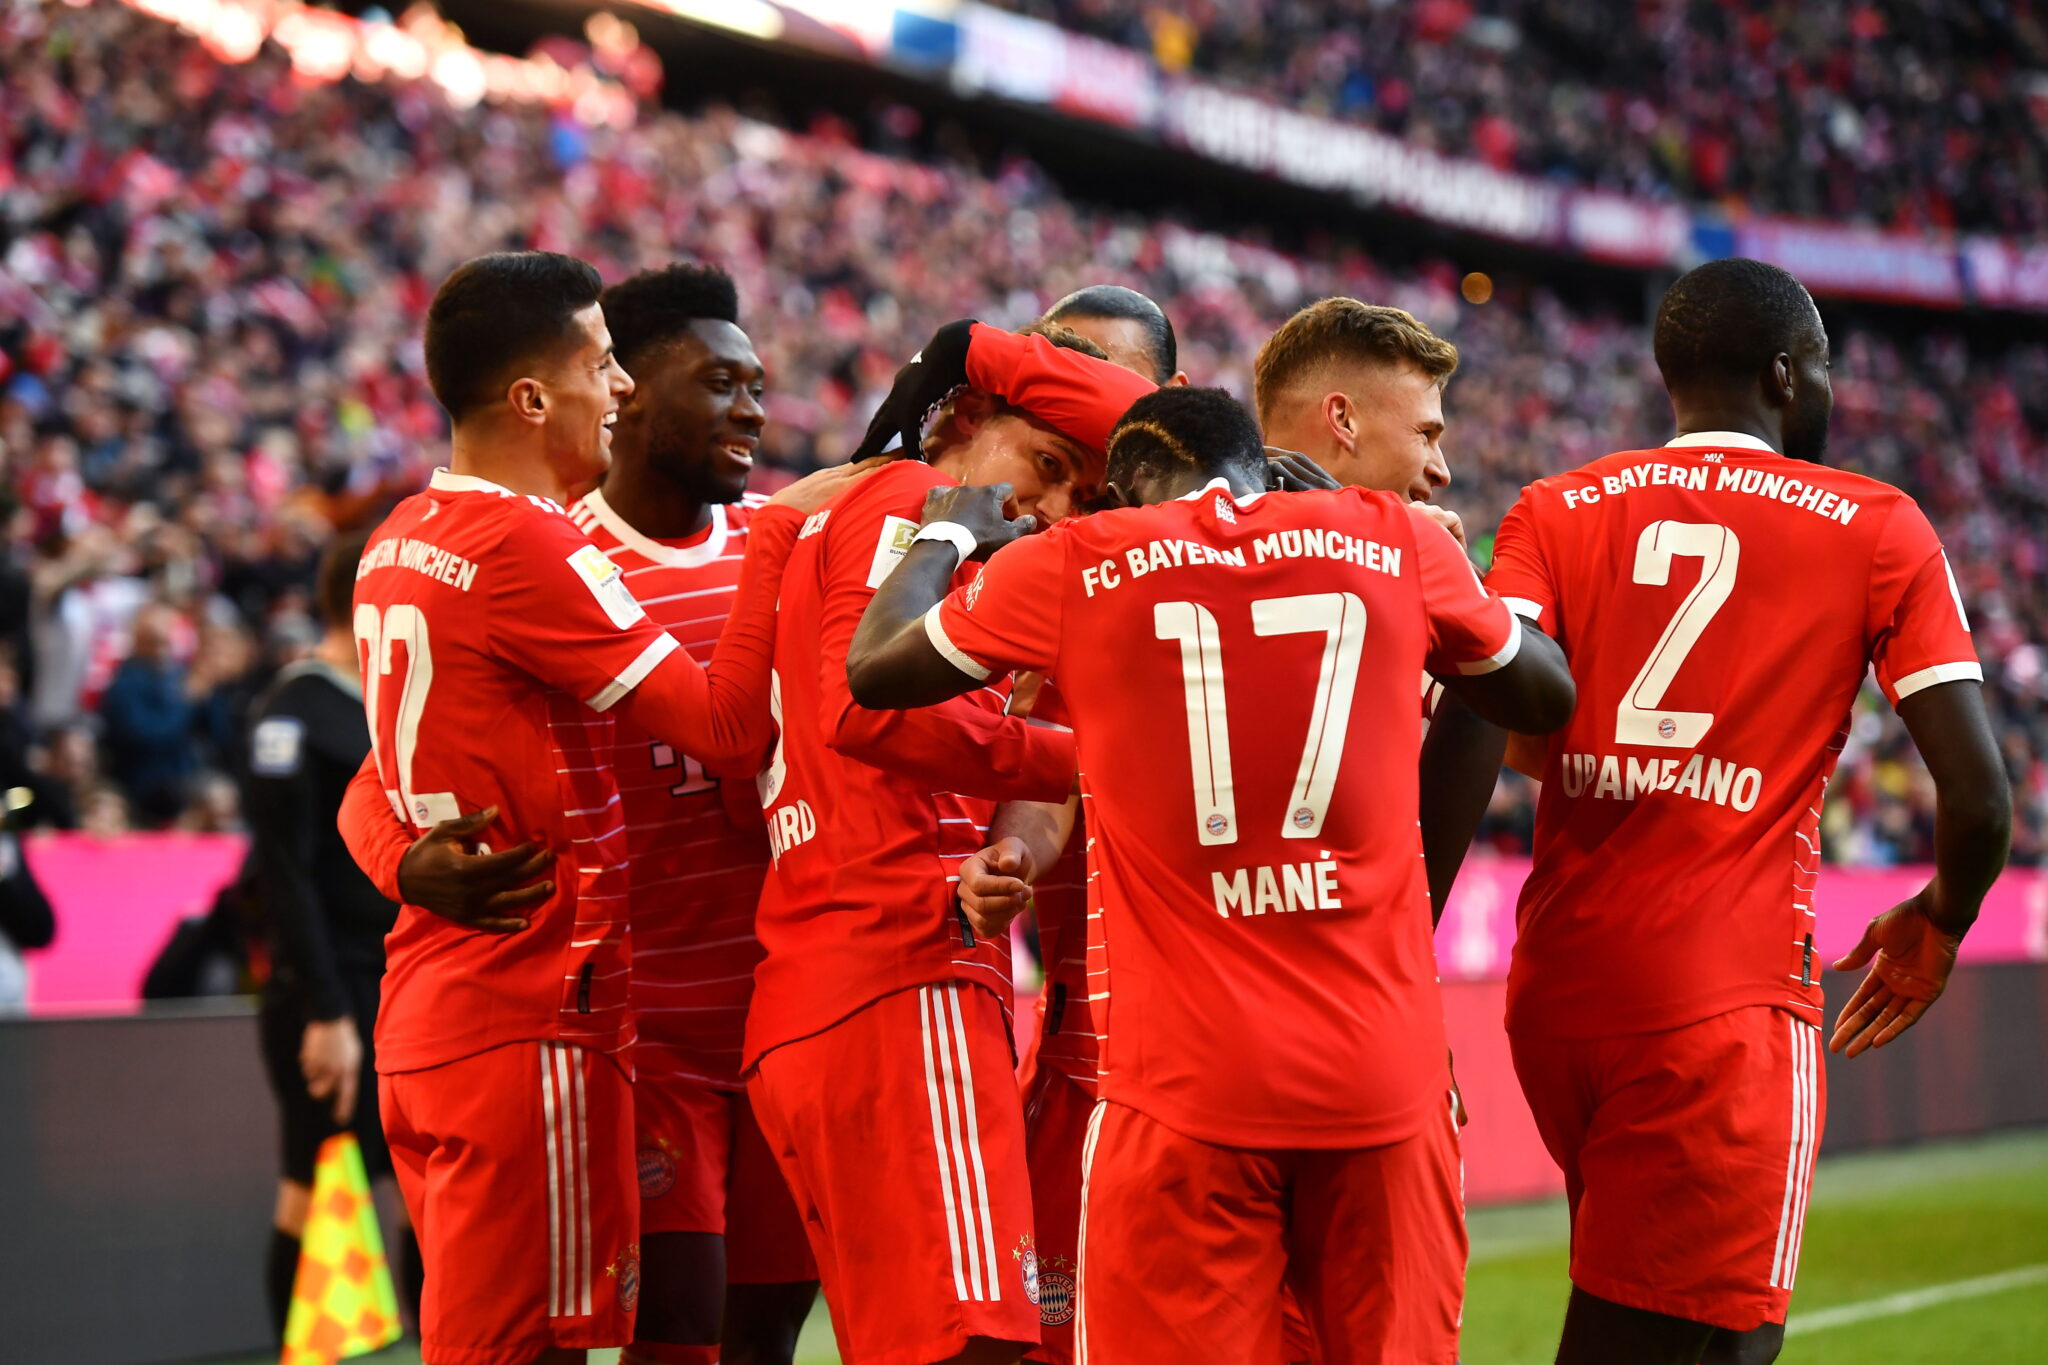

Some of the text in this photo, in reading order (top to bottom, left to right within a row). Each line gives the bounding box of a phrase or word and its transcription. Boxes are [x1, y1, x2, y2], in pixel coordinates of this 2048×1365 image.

[1562, 462, 1859, 526] FC BAYERN MÜNCHEN
[1081, 528, 1402, 598] FC BAYERN MÜNCHEN
[1614, 519, 1740, 748] 2
[1154, 591, 1367, 846] 17
[767, 799, 816, 871] VARD
[1211, 849, 1342, 918] MANÉ
[1040, 1306, 1074, 1323] NCHEN
